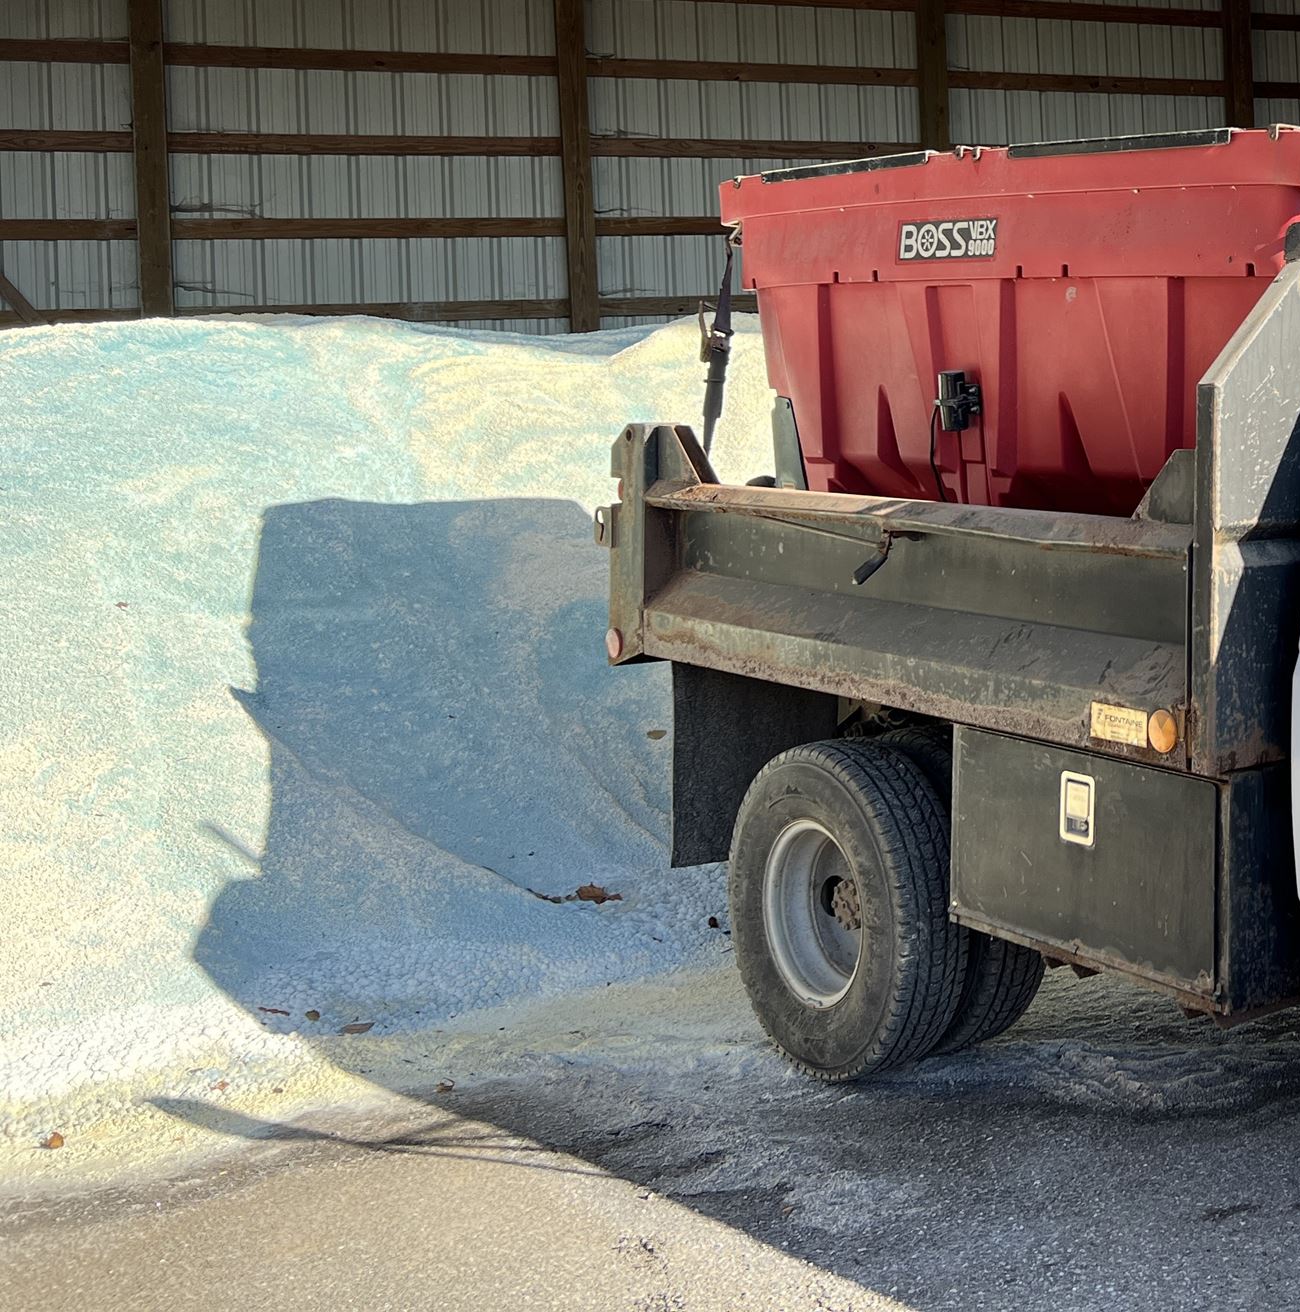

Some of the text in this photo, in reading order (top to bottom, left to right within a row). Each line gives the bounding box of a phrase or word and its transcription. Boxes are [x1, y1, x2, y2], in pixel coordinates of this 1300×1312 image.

[900, 219, 997, 259] BOSS VBX
[967, 239, 995, 256] 9000
[1104, 714, 1143, 729] FONTAINE
